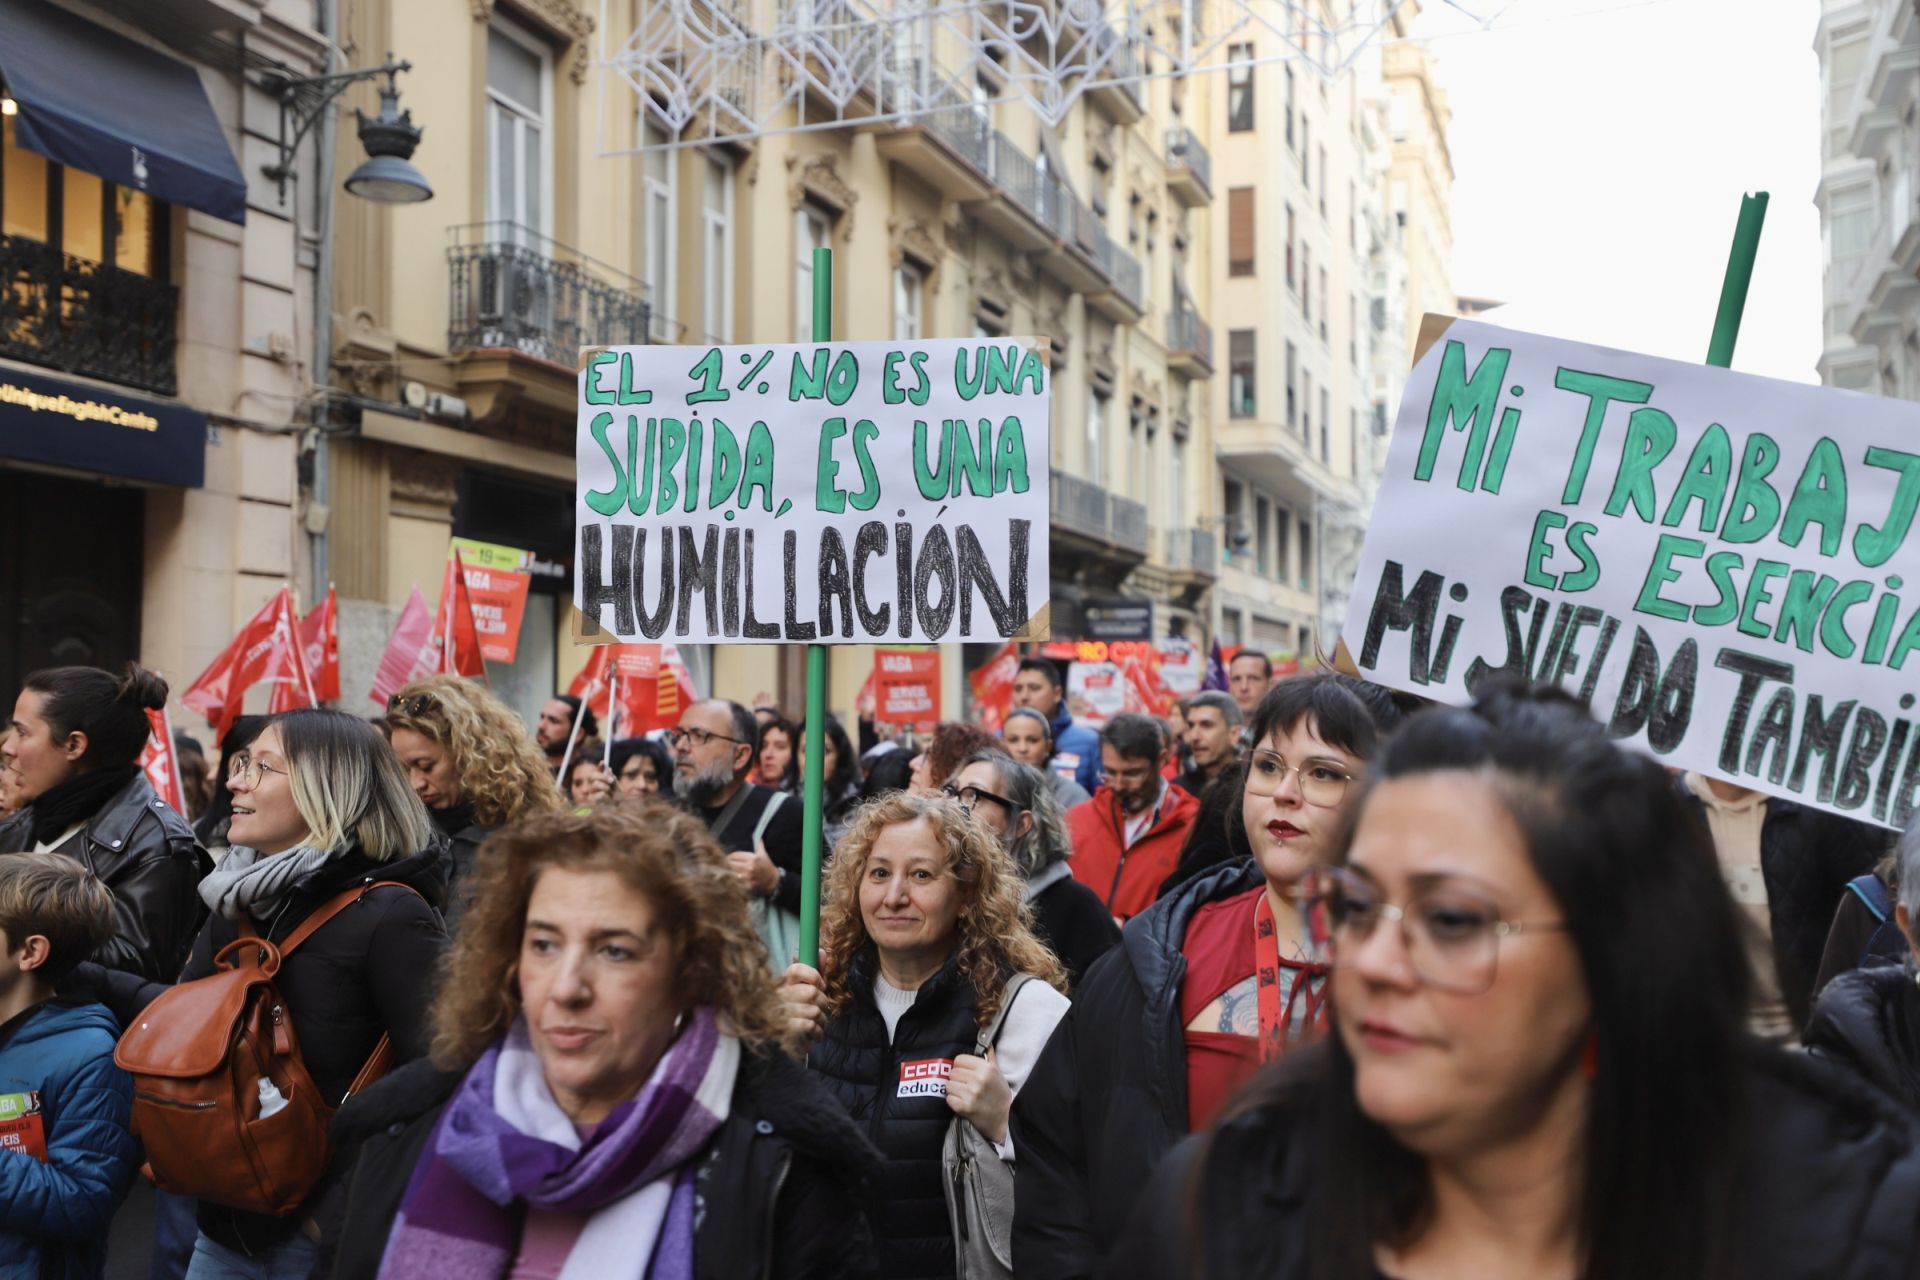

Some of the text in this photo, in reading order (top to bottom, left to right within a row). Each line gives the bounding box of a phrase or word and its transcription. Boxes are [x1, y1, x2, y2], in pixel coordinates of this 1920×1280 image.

[584, 350, 653, 405] EL
[788, 347, 860, 406] NO
[882, 350, 931, 406] ES
[954, 345, 1044, 401] UNA
[815, 416, 881, 514] ES
[912, 415, 1030, 501] UNA
[581, 504, 1032, 642] HUMILLACIÓN
[1524, 510, 1600, 592] ES
[0, 1097, 17, 1114] GA
